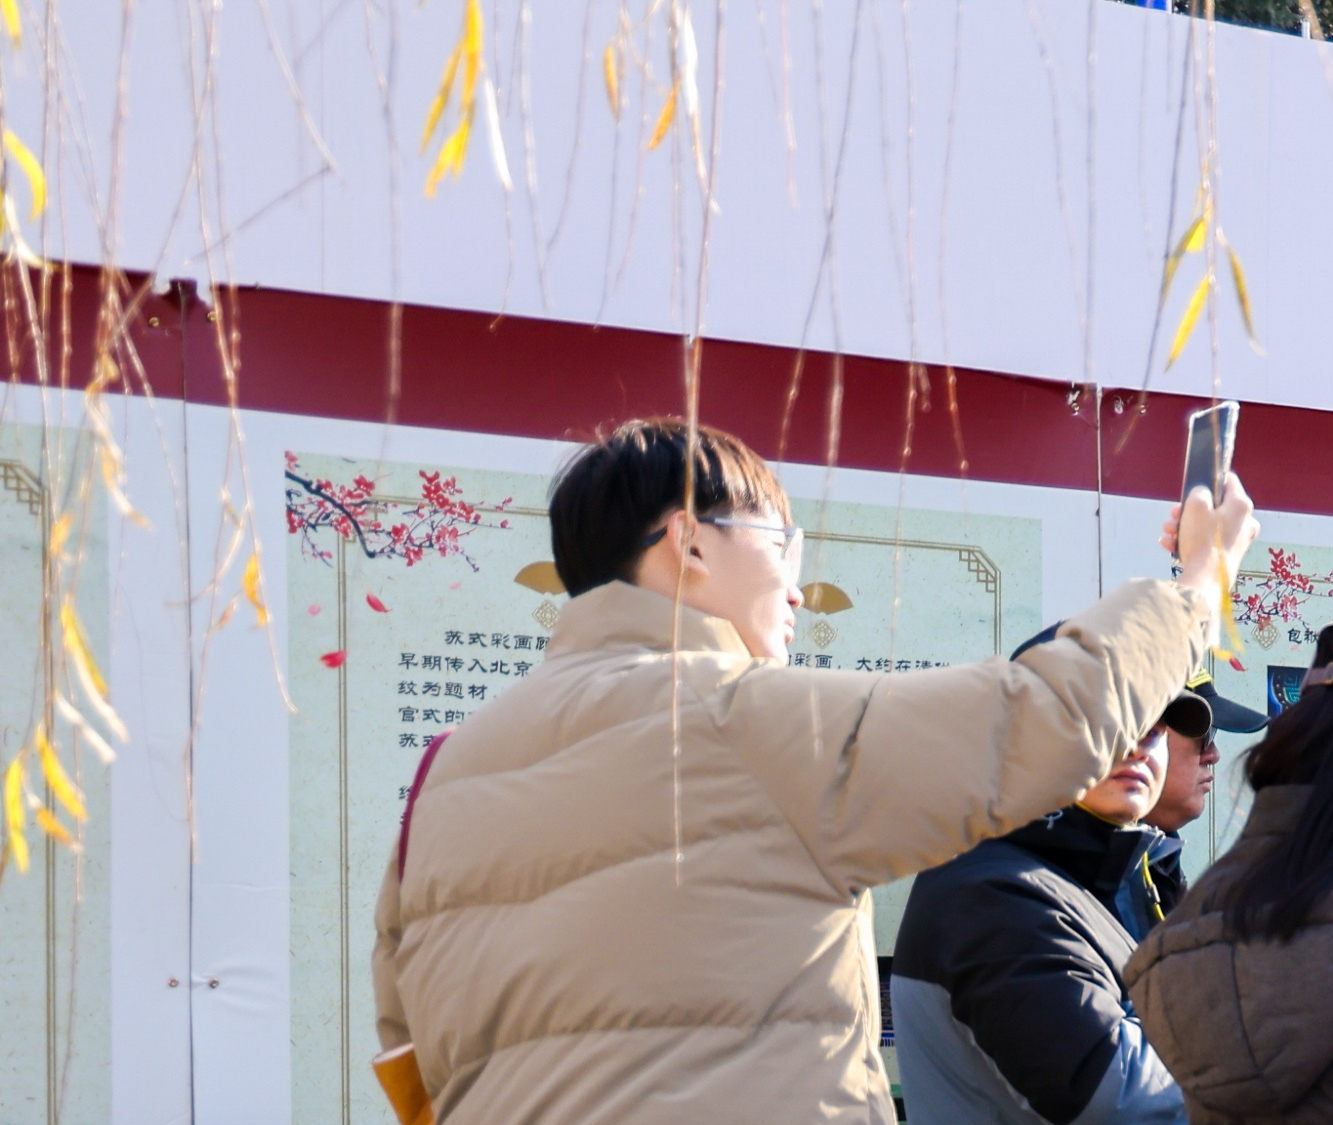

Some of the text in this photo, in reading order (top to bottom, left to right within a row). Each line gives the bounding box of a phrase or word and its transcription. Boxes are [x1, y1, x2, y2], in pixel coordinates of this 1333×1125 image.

[398, 652, 533, 678] 早期传入北京
[787, 652, 950, 673] 彩画，大约在清
[398, 705, 474, 725] 官式的
